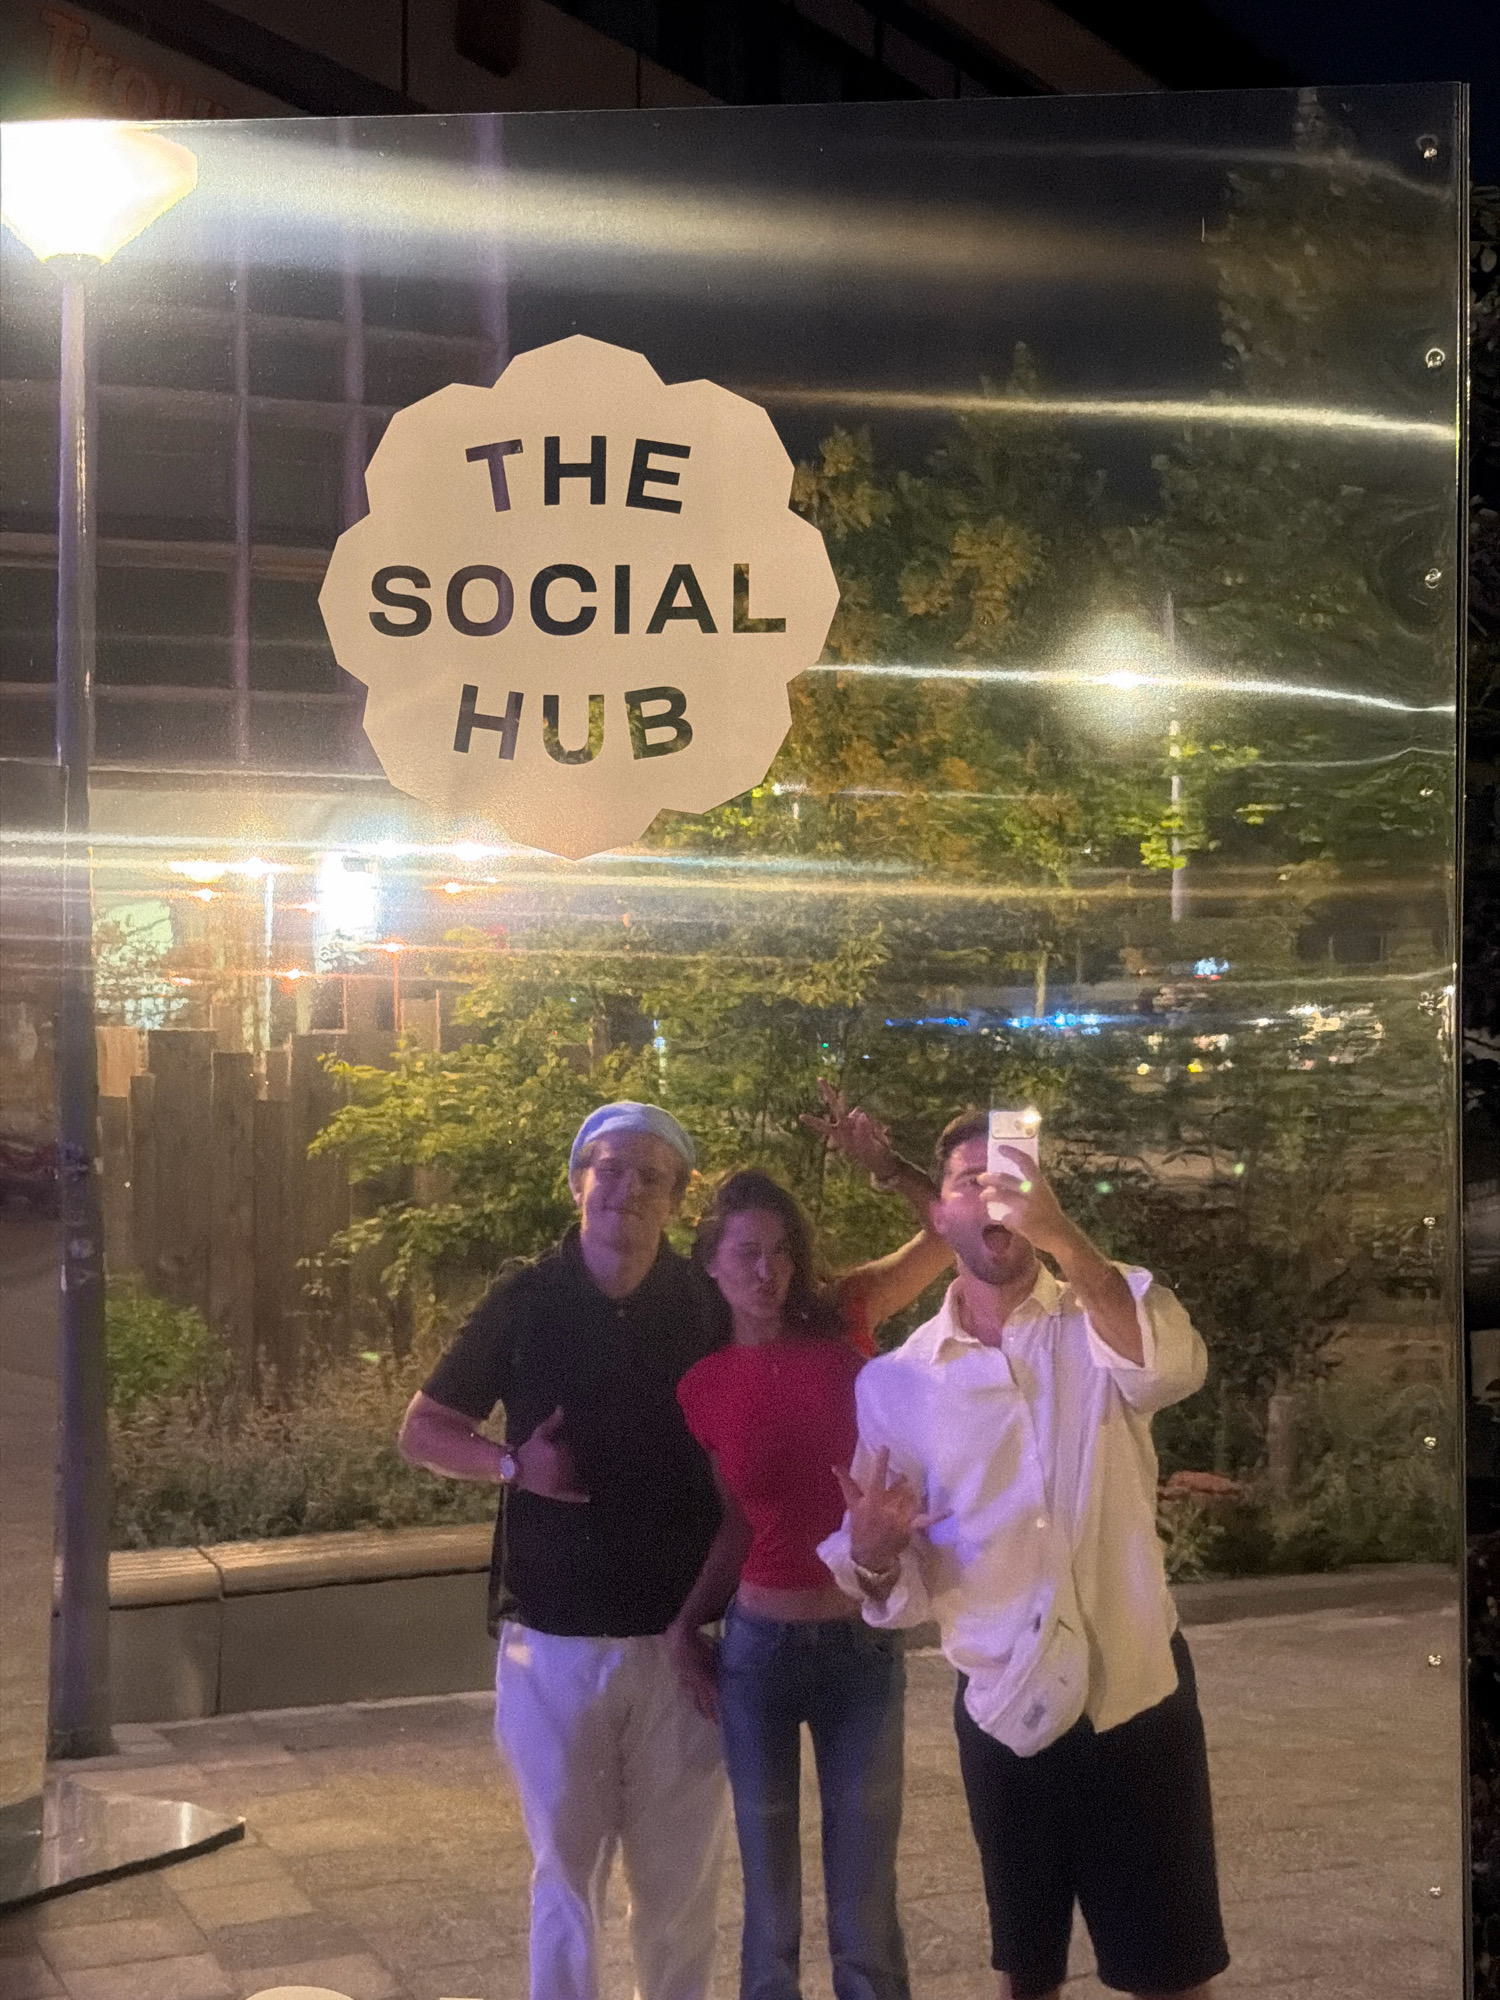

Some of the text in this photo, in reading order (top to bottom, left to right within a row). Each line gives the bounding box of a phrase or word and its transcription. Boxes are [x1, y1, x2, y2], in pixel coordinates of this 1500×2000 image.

[465, 435, 691, 514] THE
[368, 563, 787, 637] SOCIAL
[453, 683, 693, 765] HUB
